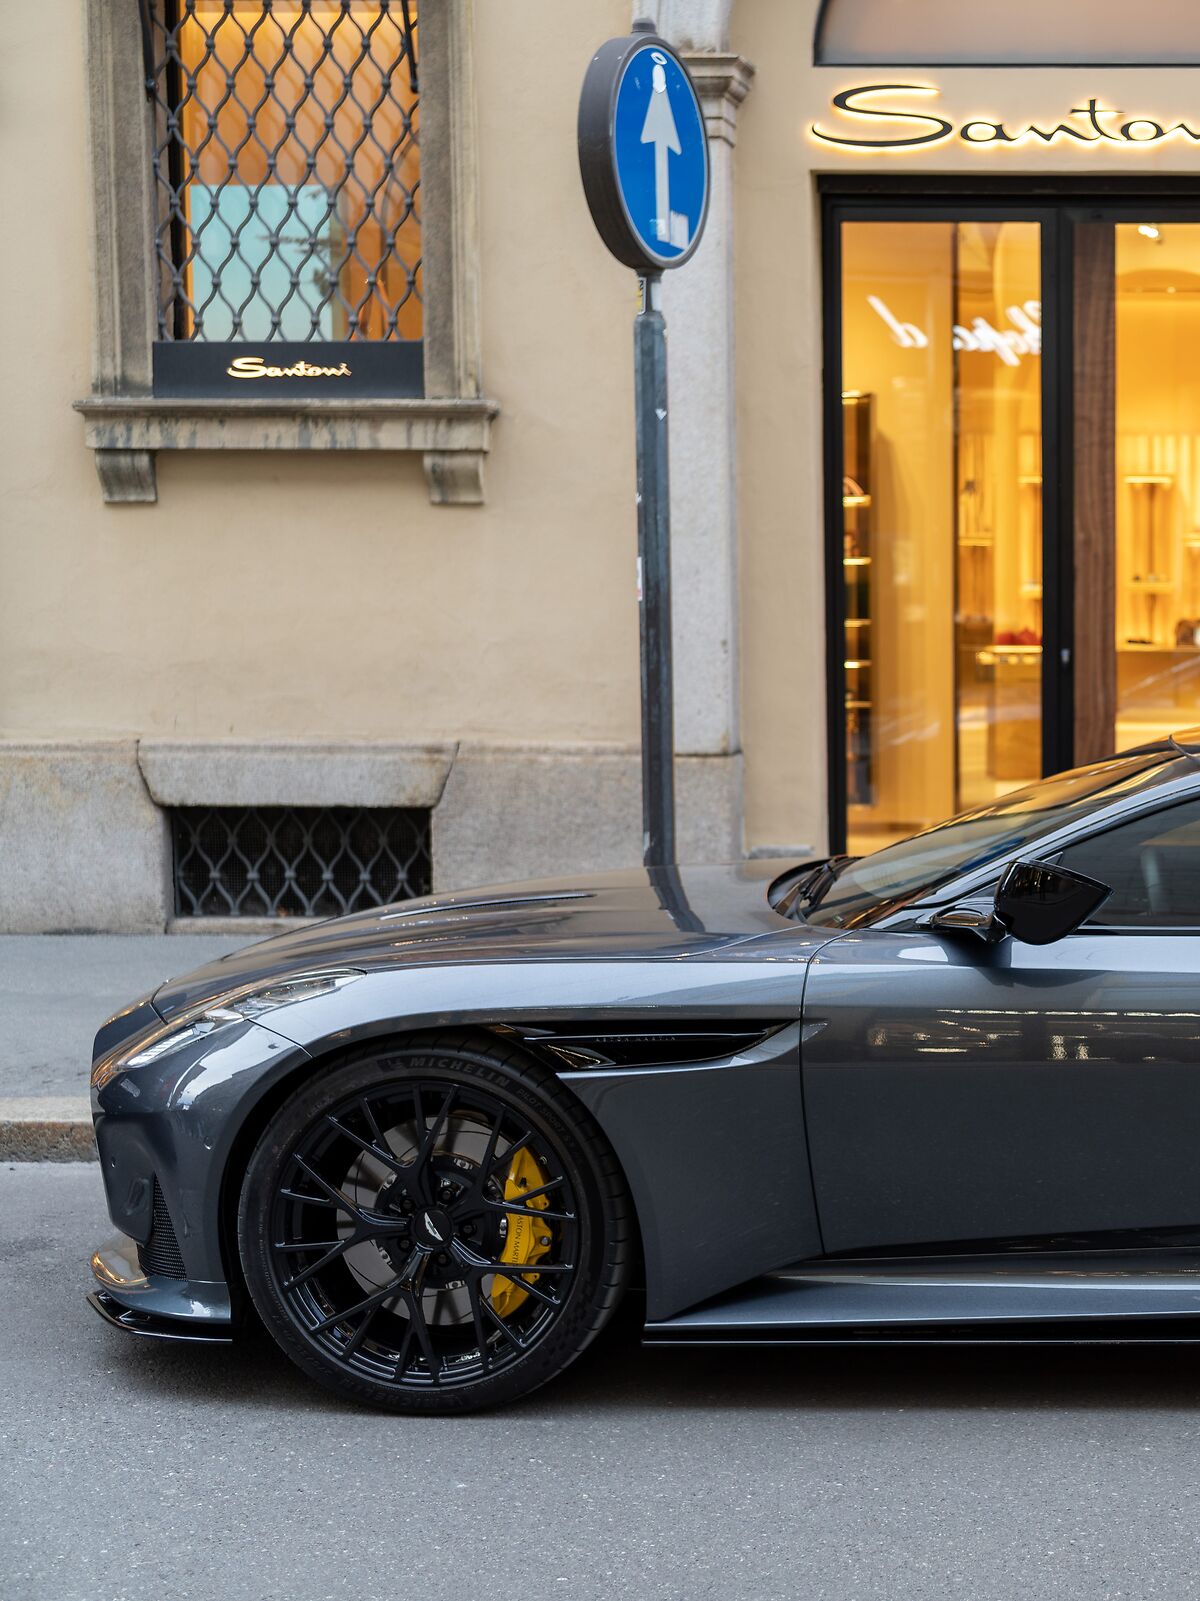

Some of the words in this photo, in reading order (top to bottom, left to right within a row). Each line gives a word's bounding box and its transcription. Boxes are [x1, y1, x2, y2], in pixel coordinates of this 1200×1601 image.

[226, 356, 352, 378] Santoni
[409, 1056, 511, 1087] MICHELIN
[514, 1215, 523, 1240] ASTON
